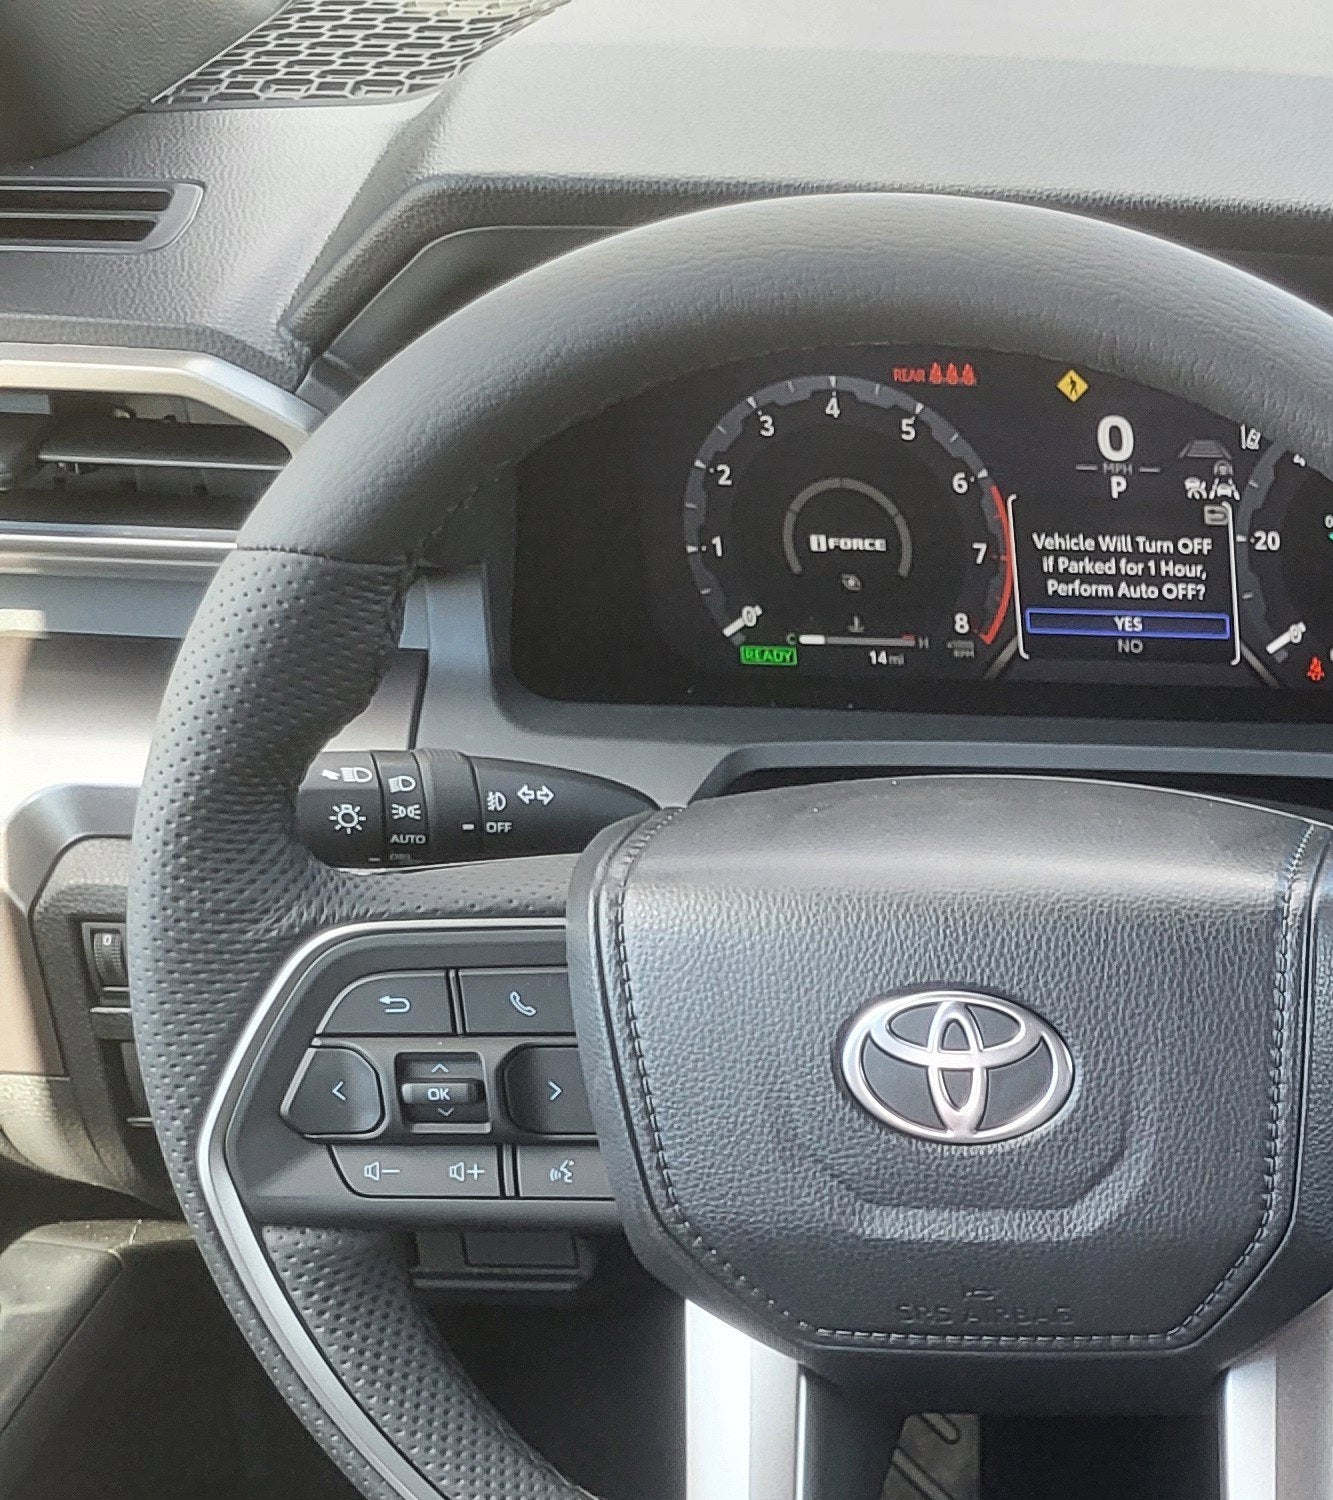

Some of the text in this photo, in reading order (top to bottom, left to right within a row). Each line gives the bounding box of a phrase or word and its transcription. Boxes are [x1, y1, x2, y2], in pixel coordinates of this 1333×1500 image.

[825, 397, 842, 419] 4
[759, 415, 776, 437] 3
[900, 417, 917, 441] 5
[1096, 414, 1135, 462] 0
[716, 463, 733, 487] 2
[950, 472, 969, 494] 6
[1110, 475, 1128, 499] P
[711, 536, 723, 557] 1
[1032, 532, 1213, 556] Vehicle Will Turn OFF
[1253, 530, 1281, 551] 20
[972, 541, 988, 565] 7
[1058, 557, 1117, 576] Parked
[1119, 557, 1145, 576] for
[1147, 559, 1157, 577] 1
[1160, 560, 1207, 581] Hour,
[1046, 579, 1207, 601] Perform Auto OFF?
[954, 612, 970, 634] 8
[1113, 616, 1143, 632] YES
[742, 649, 795, 664] READY
[1117, 638, 1144, 653] NO
[485, 821, 513, 834] OFF
[389, 833, 427, 846] AUTO
[427, 1088, 451, 1102] OK
